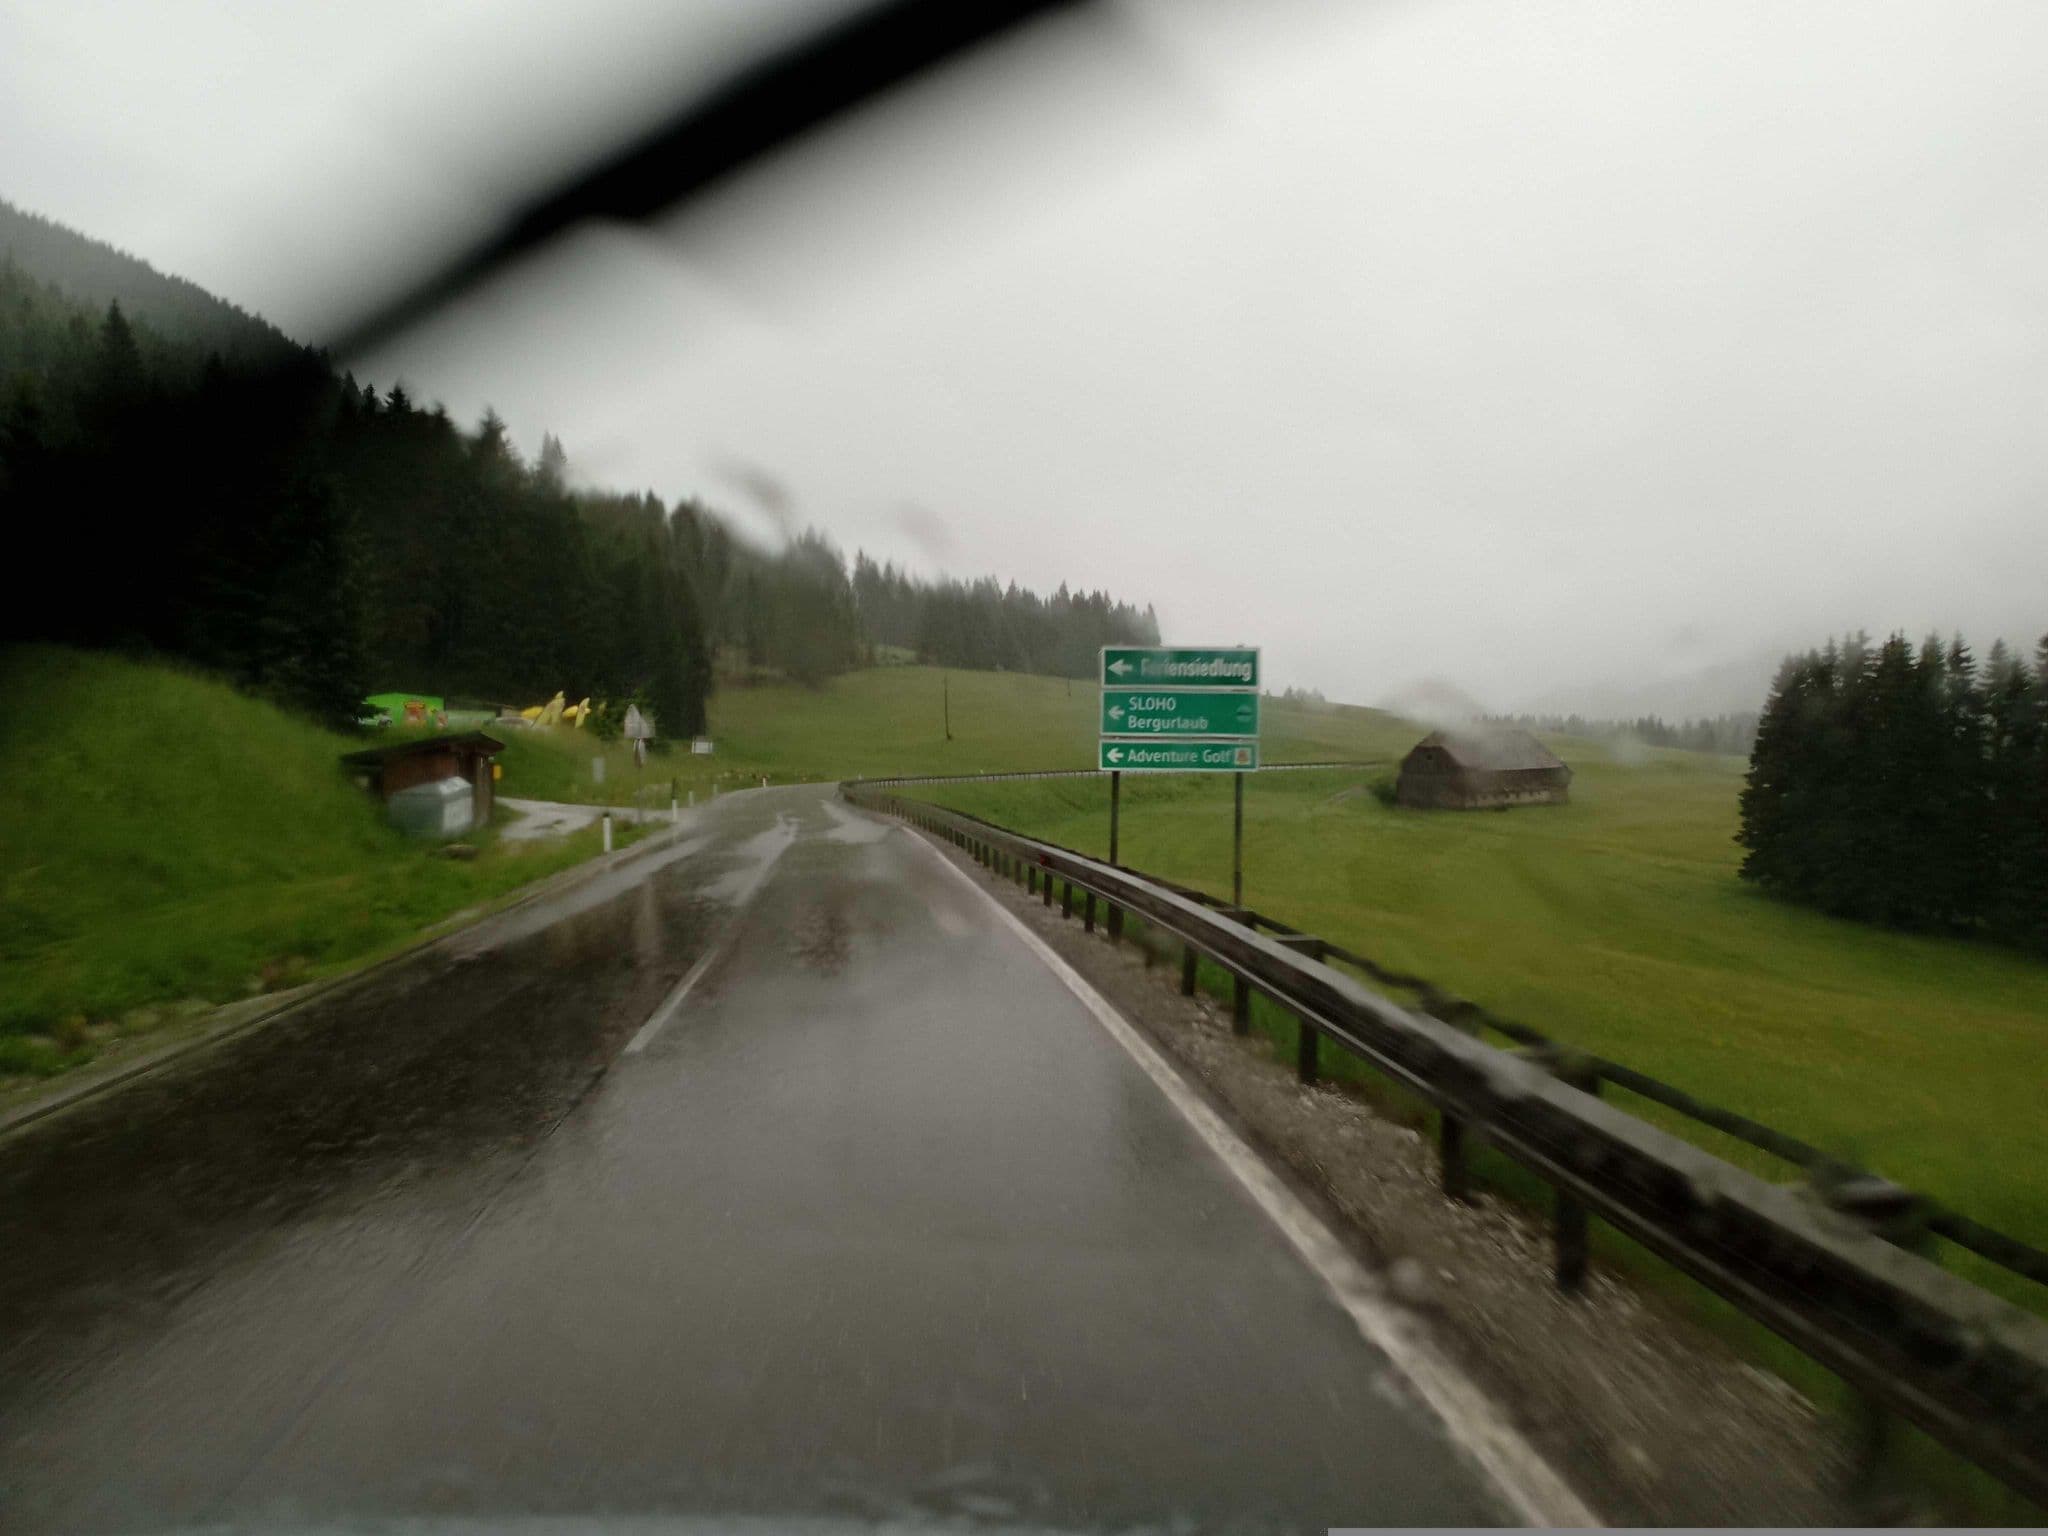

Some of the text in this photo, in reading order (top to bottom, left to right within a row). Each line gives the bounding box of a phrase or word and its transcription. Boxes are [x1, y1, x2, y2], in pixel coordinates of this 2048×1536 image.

[1128, 696, 1176, 712] SLOHO
[1128, 715, 1209, 731] Bergurlaub
[1128, 749, 1233, 763] Adventure Golf
